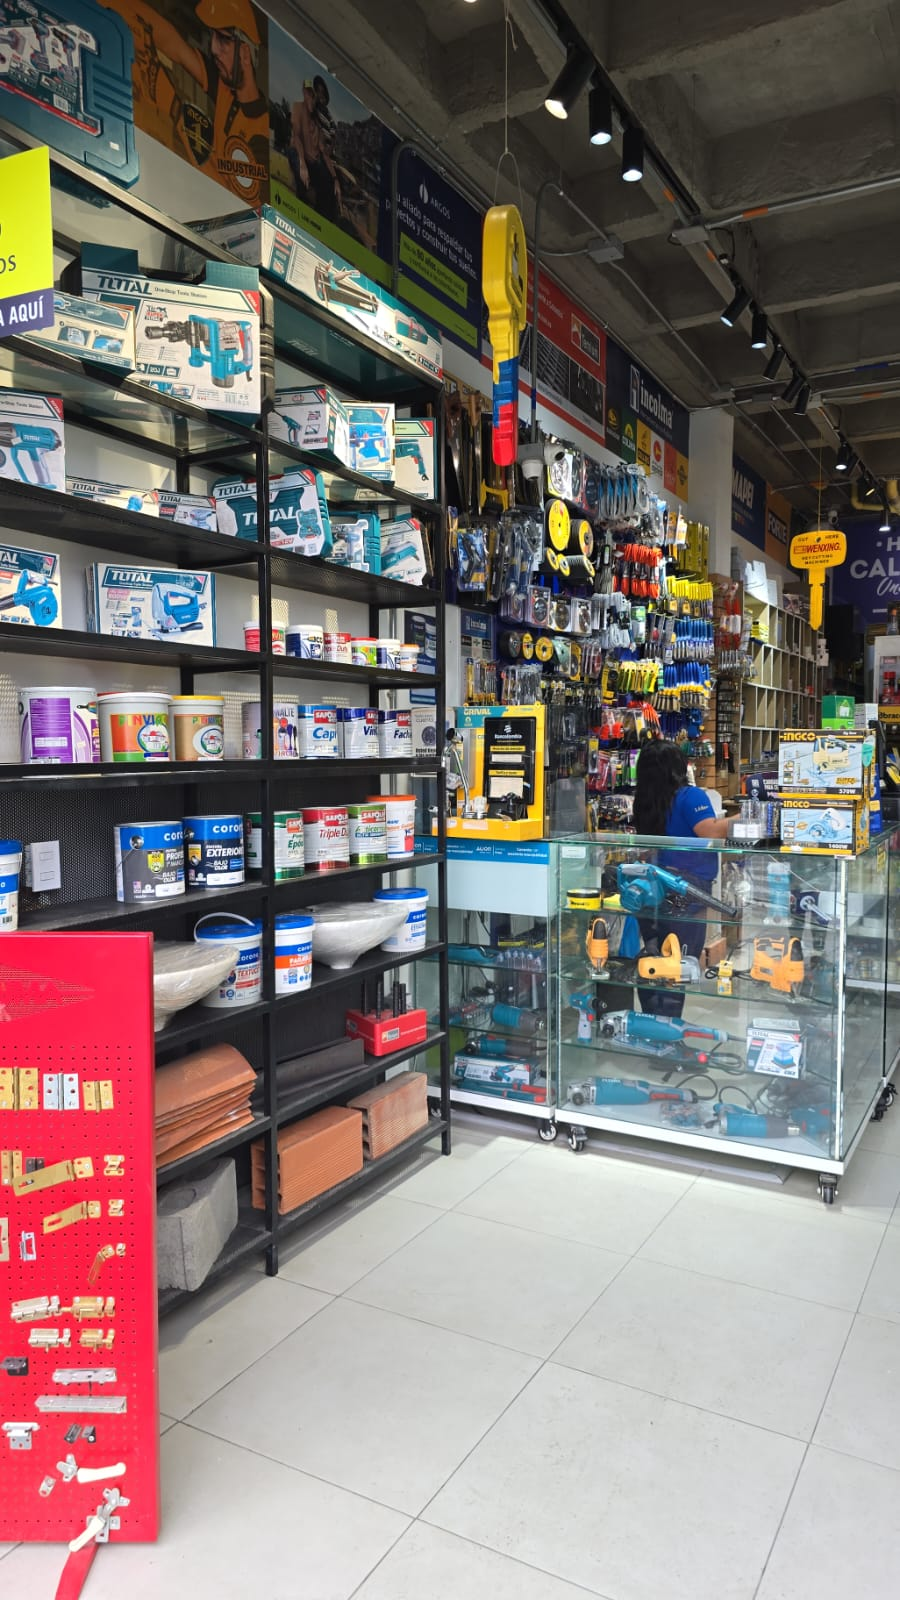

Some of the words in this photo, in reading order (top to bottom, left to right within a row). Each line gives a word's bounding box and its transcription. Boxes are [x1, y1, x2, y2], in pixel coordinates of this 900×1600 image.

[217, 159, 267, 178] INDUSTRIAL
[275, 215, 297, 238] TOTAL
[97, 275, 153, 295] TOTAL
[9, 295, 44, 326] AQUÍ
[640, 379, 674, 430] incolma
[72, 483, 97, 493] TOTAL
[218, 483, 251, 497] TOTAL
[111, 570, 153, 583] TOTAL
